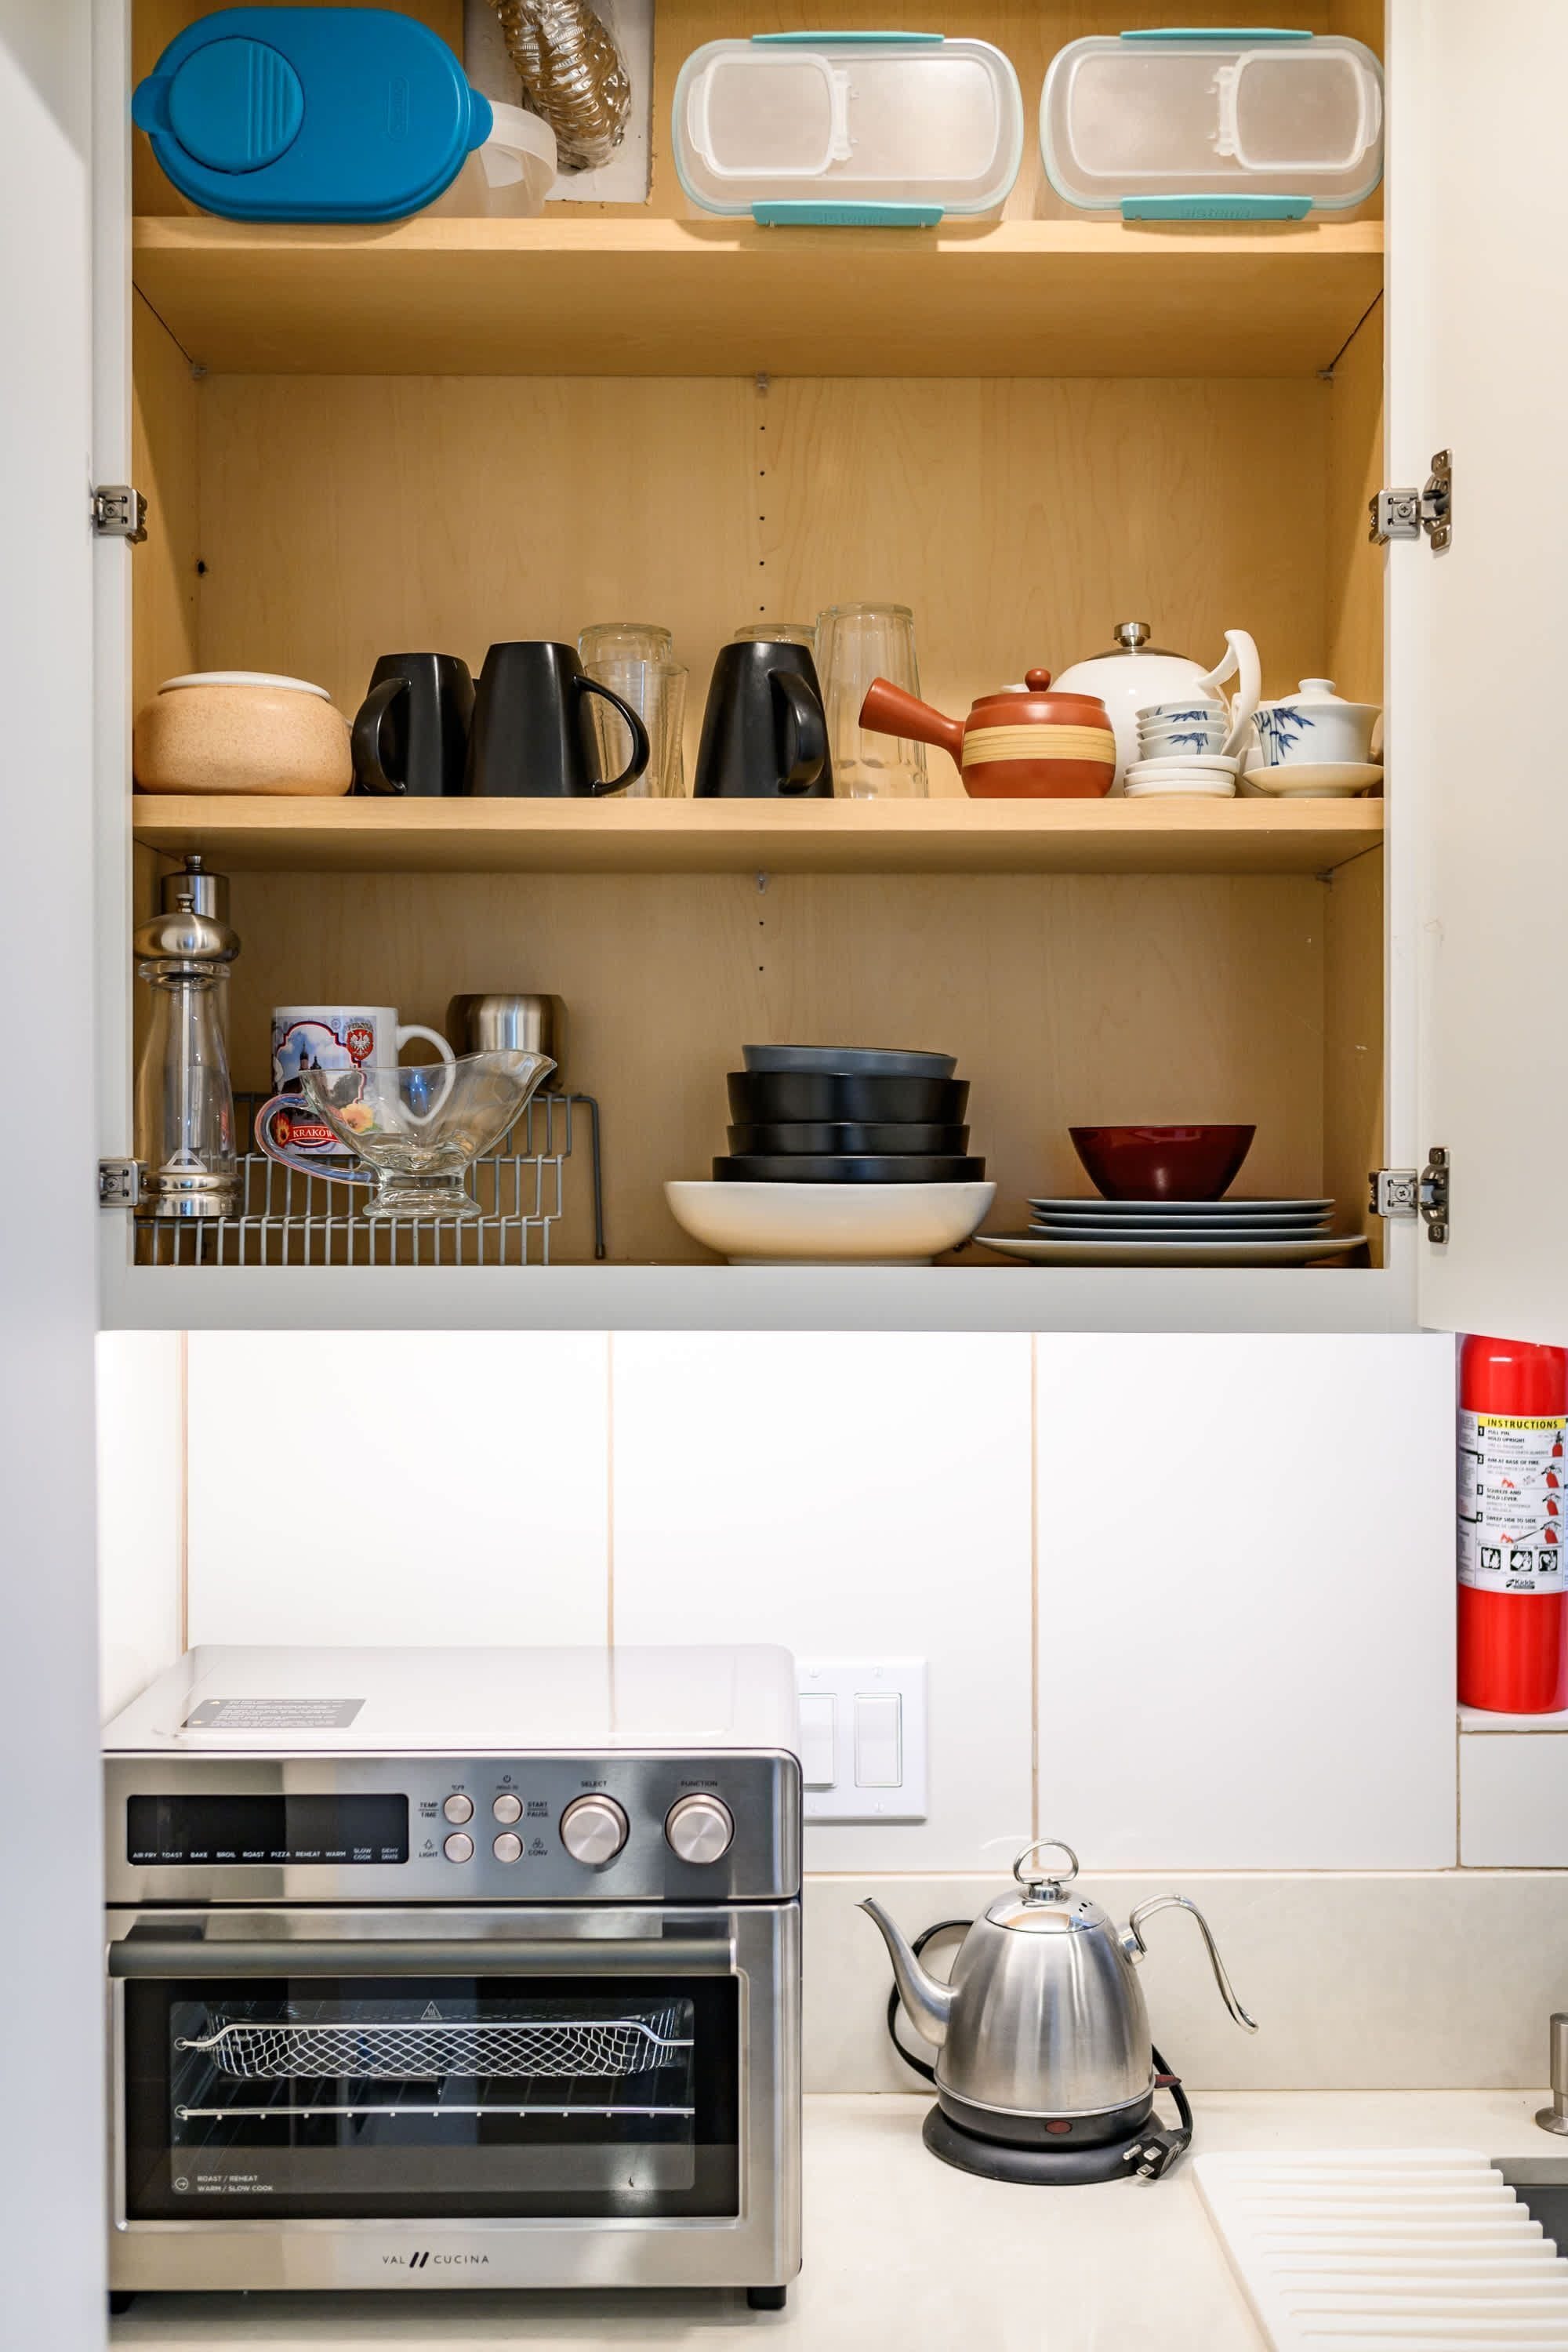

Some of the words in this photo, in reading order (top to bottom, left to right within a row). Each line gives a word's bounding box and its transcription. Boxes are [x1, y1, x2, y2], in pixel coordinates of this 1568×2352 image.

[1487, 1418, 1558, 1429] INSTRUCTIONS
[383, 2256, 405, 2264] VAL
[434, 2255, 490, 2264] CUCINA
